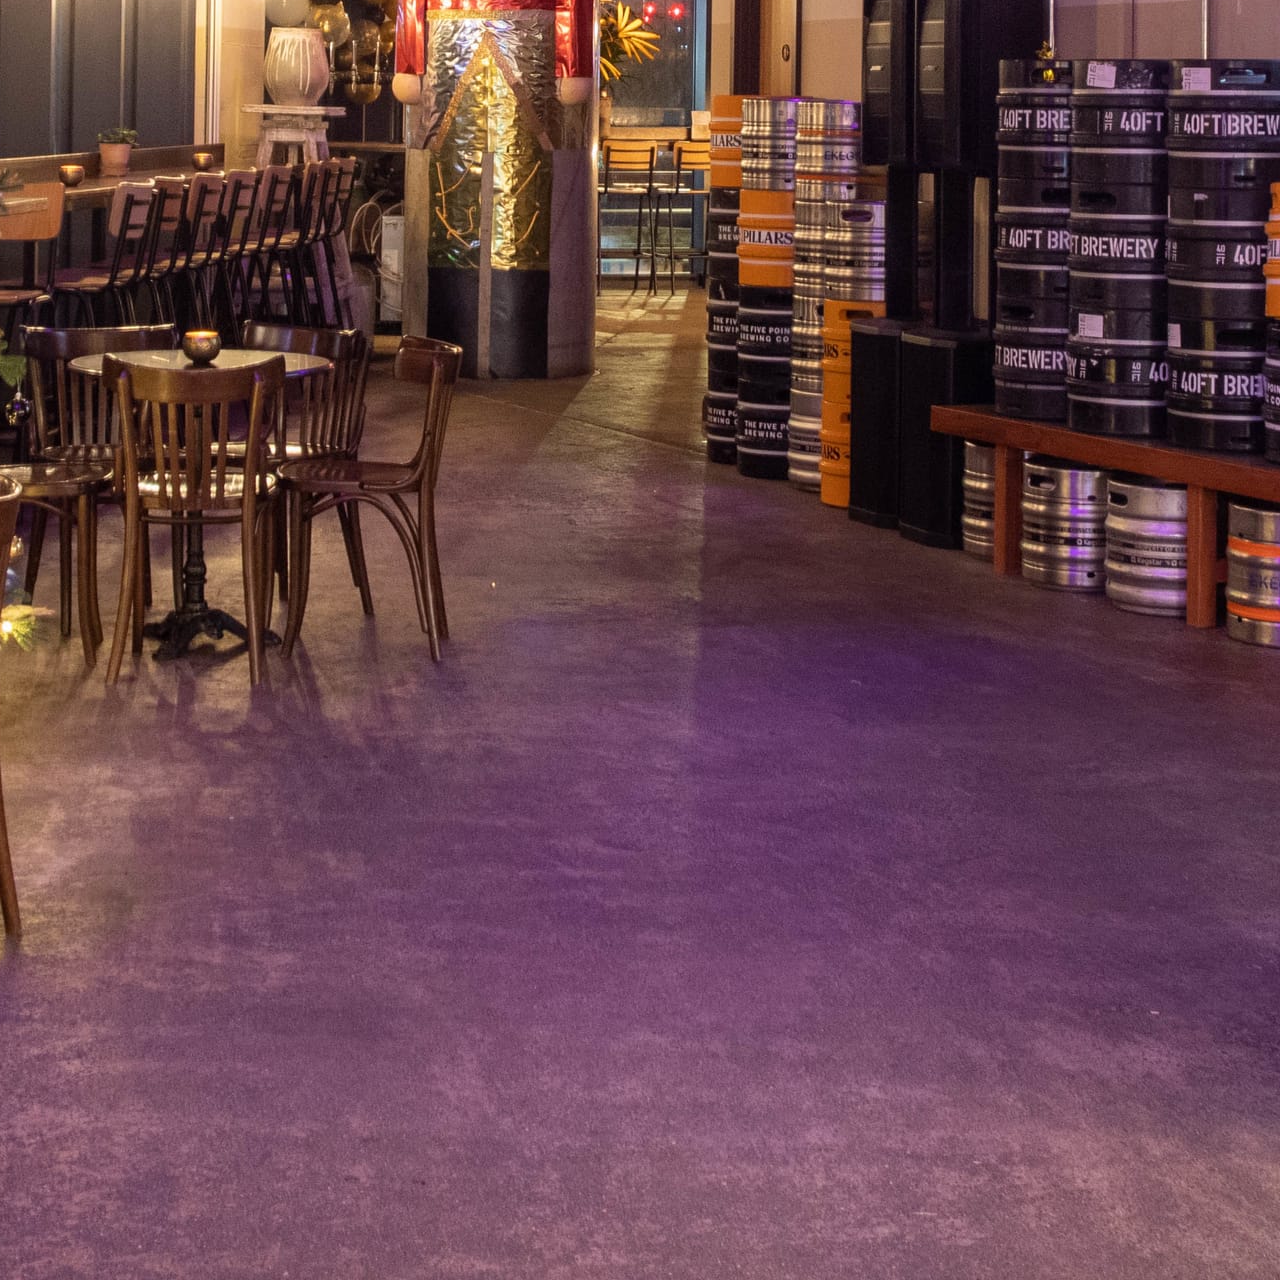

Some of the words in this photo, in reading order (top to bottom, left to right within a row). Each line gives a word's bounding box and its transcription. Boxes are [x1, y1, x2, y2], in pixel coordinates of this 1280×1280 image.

[1004, 108, 1033, 129] 40FT
[1120, 111, 1164, 132] 40FT
[1183, 113, 1221, 135] 40FT
[743, 230, 793, 245] PILLARS
[1009, 229, 1042, 249] 40FT
[1081, 236, 1158, 259] BREWERY
[740, 332, 772, 343] BREWING
[750, 325, 766, 334] FIVE
[1181, 371, 1218, 395] 40FT
[744, 420, 757, 429] THE
[759, 422, 777, 431] FIVE
[744, 428, 783, 439] BREWING
